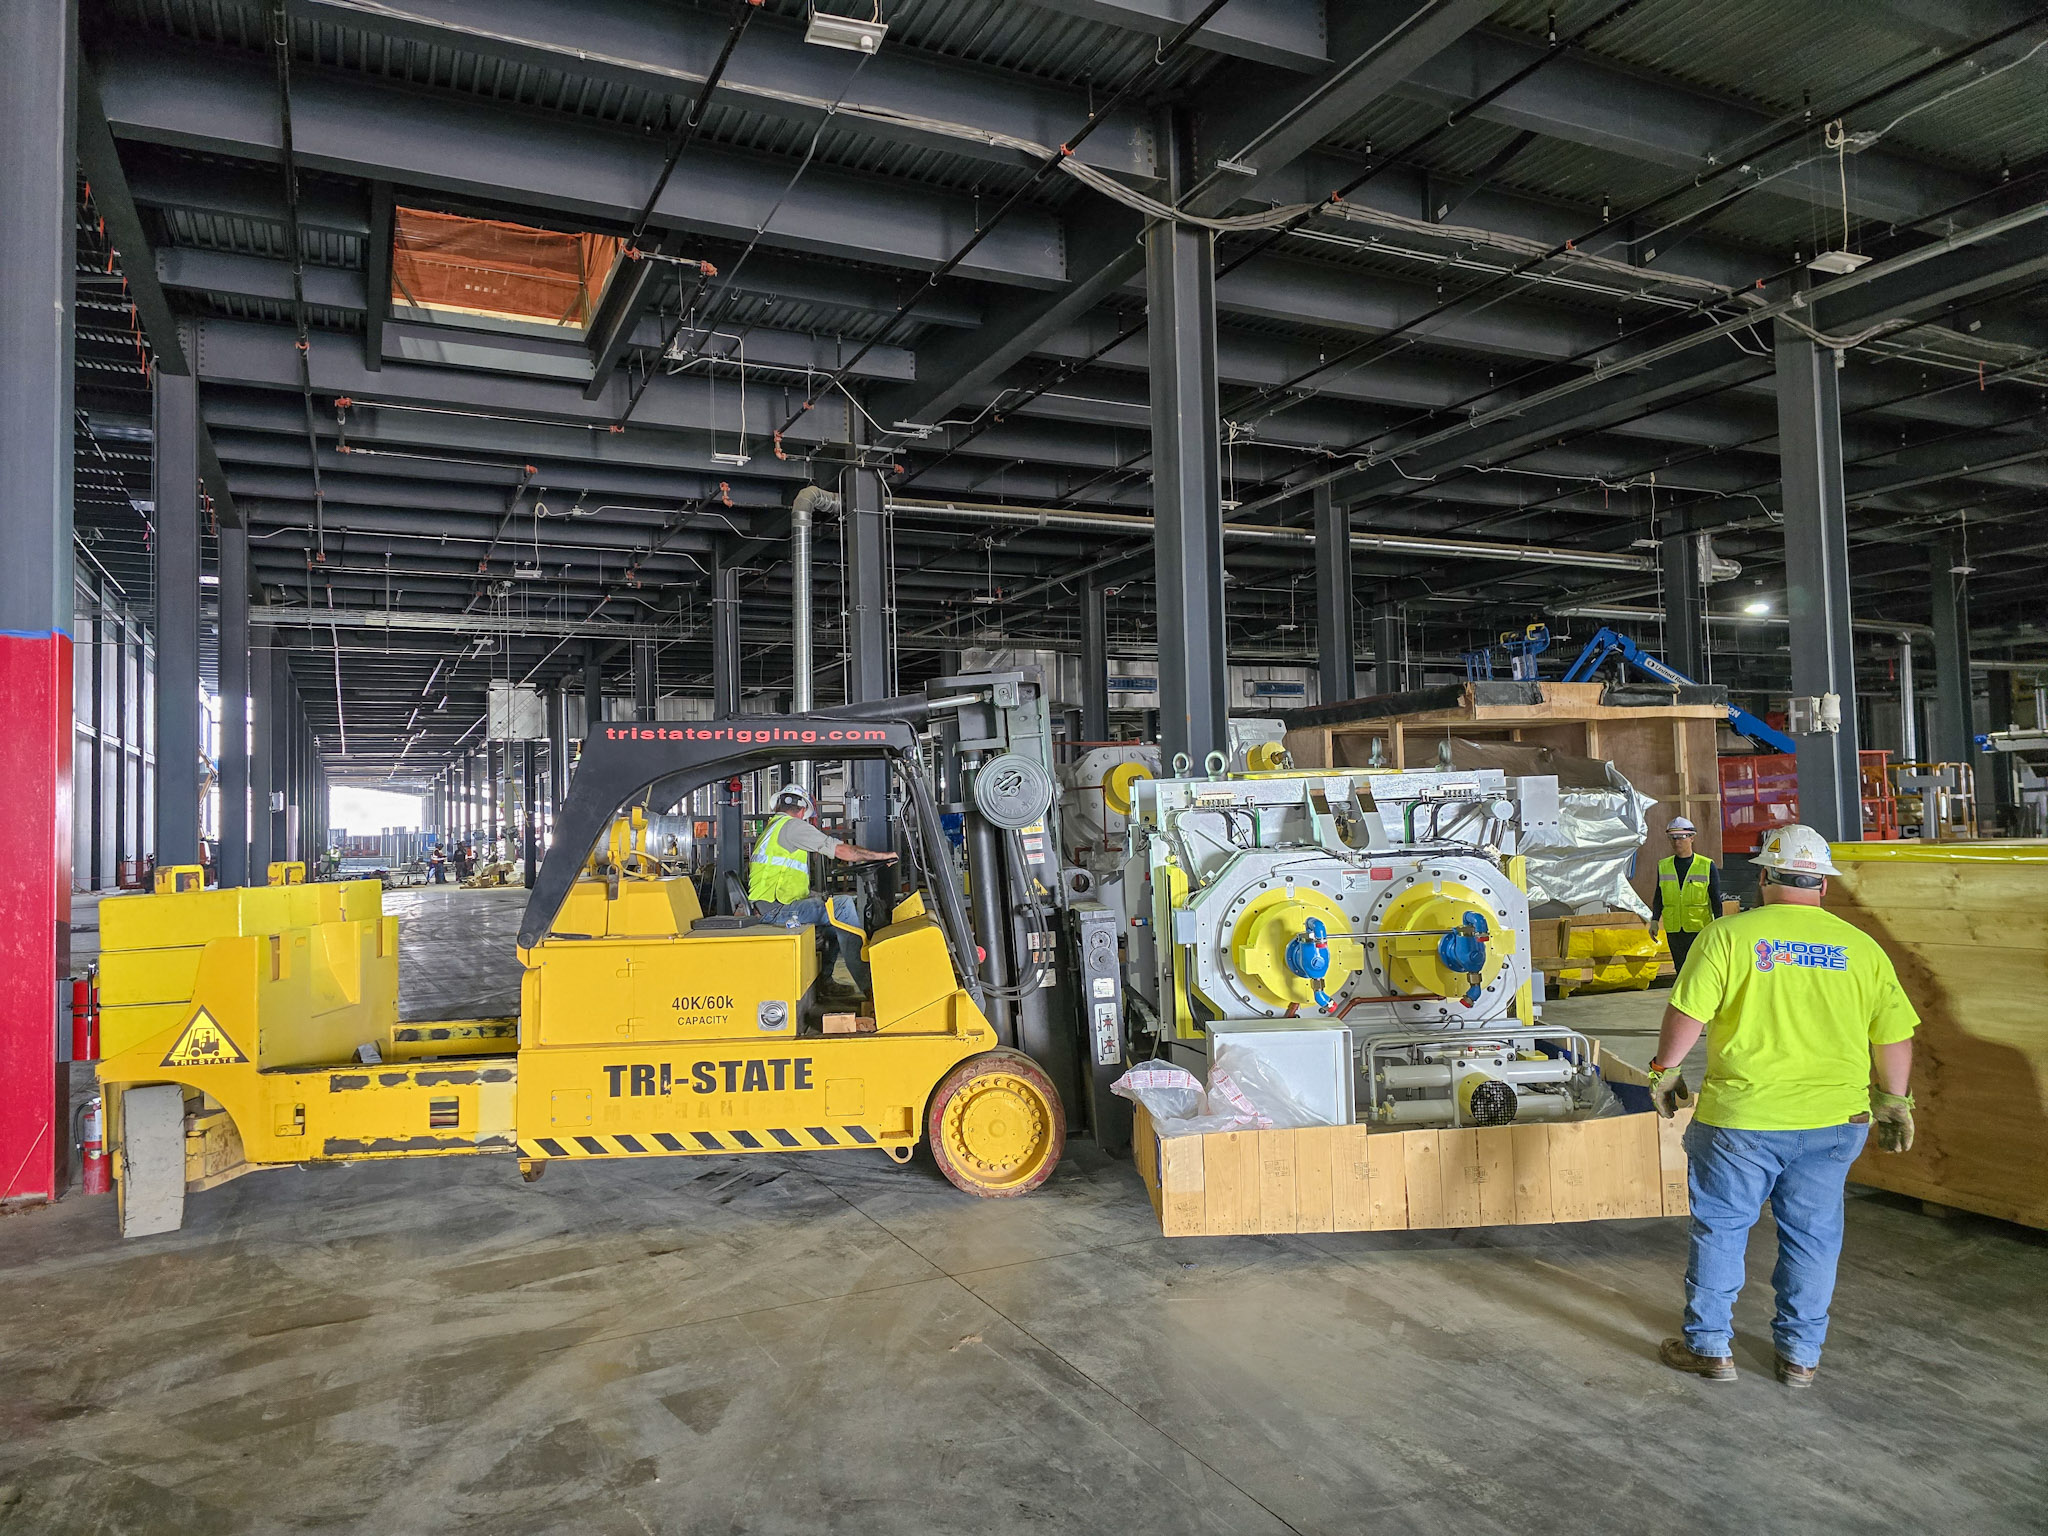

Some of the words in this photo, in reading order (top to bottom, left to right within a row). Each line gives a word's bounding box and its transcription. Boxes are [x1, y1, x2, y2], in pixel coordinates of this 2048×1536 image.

[1655, 665, 1675, 679] United
[606, 727, 886, 743] tristaterigging.com
[1774, 941, 1846, 957] HOOK
[672, 995, 734, 1010] 40K/60k
[678, 1015, 728, 1025] CAPACITY
[173, 1057, 236, 1066] TRI-STATE
[603, 1057, 814, 1098] TRI-STATE
